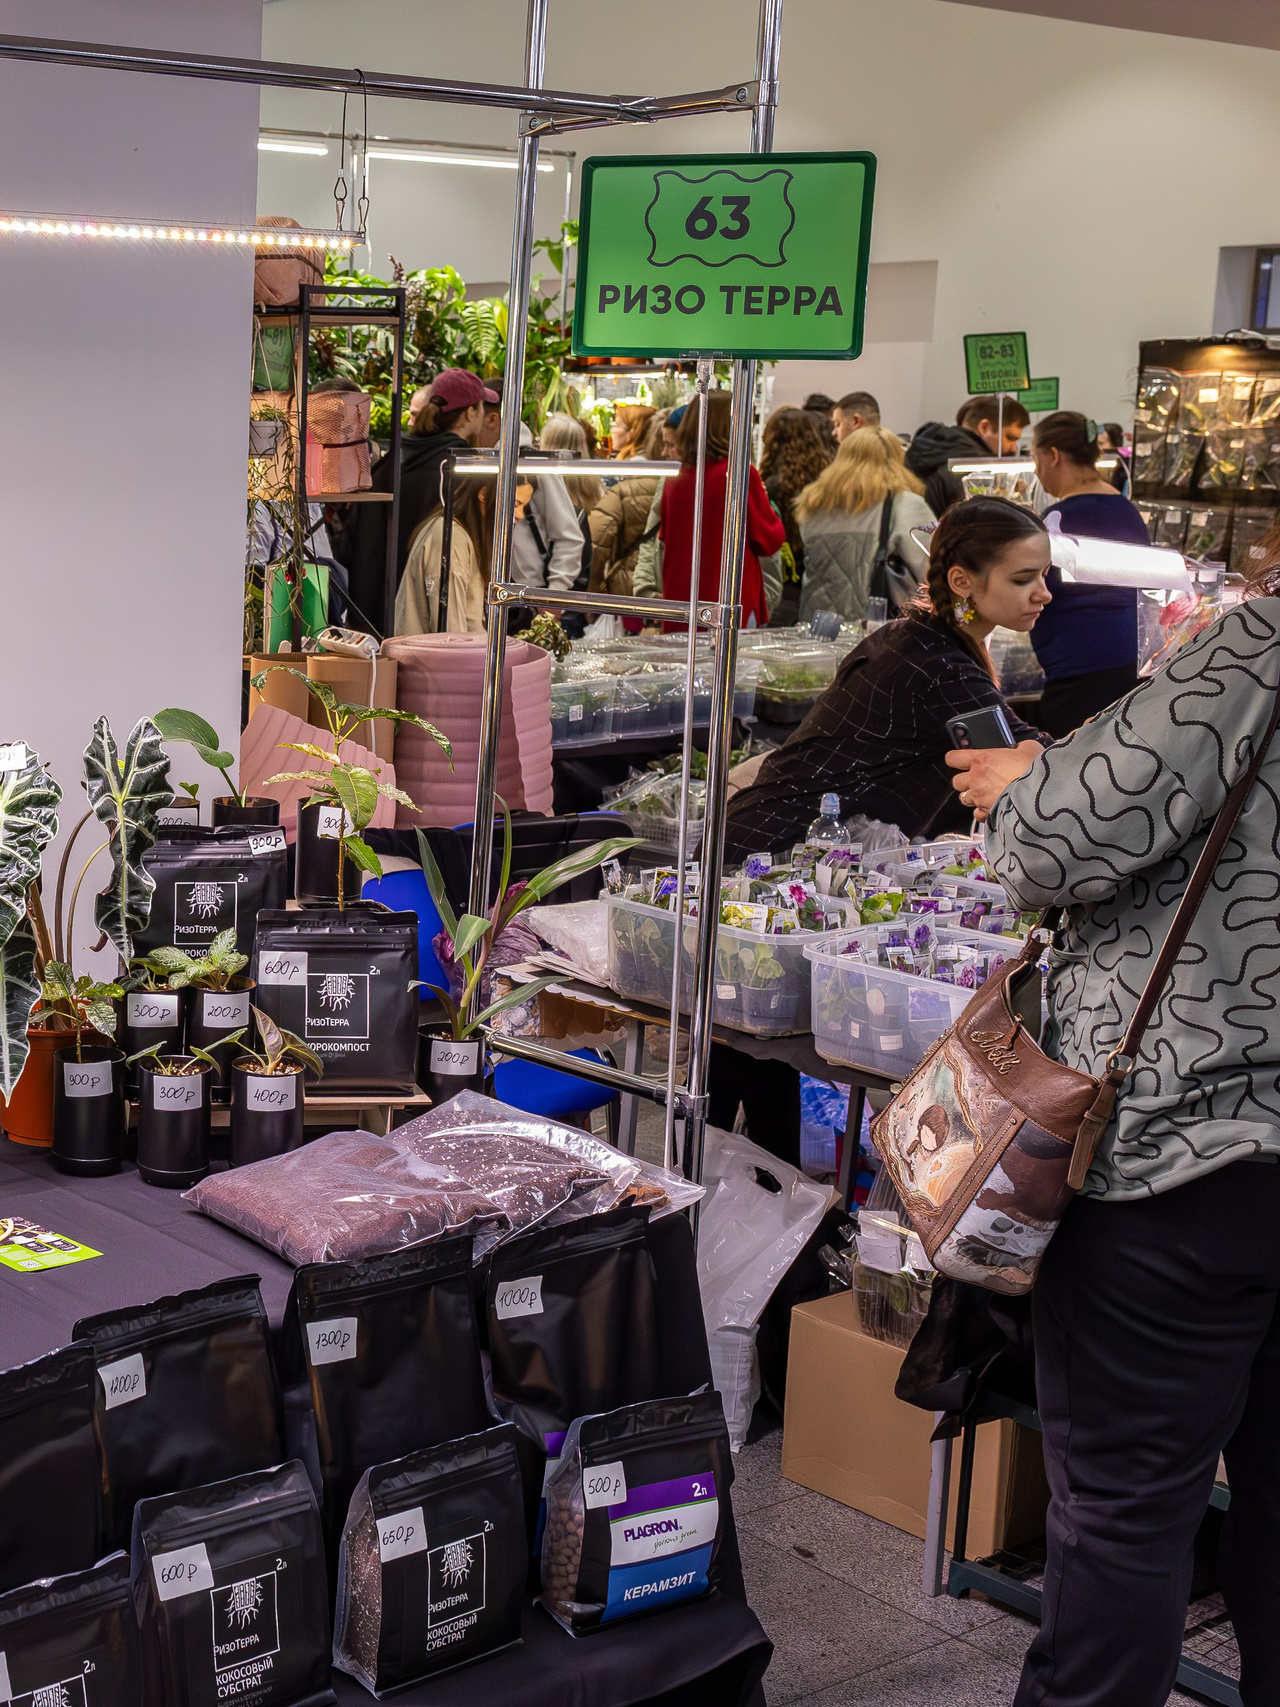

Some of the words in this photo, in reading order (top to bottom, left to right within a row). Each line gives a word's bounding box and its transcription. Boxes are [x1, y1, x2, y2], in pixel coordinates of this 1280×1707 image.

[685, 195, 751, 240] 63
[597, 284, 706, 315] РИЗО
[719, 285, 844, 316] ТЕРРА
[980, 344, 1015, 359] 82-83
[980, 370, 1019, 380] BEGONIA
[237, 873, 249, 883] 2л
[369, 965, 381, 976] 2л
[133, 1004, 171, 1021] 300₽
[207, 1005, 242, 1020] 200₽
[436, 1051, 470, 1067] 200₽
[69, 1074, 101, 1089] 900₽
[160, 1086, 196, 1101] 300₽
[498, 1287, 538, 1309] 1000₽
[315, 1330, 351, 1351] 1300₽
[109, 1373, 140, 1396] 1200₽
[691, 1482, 708, 1497] 2л
[382, 1525, 415, 1546] 650₽
[483, 1520, 495, 1533] 2л
[652, 1535, 679, 1554] glorious
[679, 1528, 698, 1543] green
[161, 1562, 198, 1584] 600₽
[275, 1558, 288, 1571] 2л
[623, 1571, 697, 1601] КЕРАМЗИТ
[427, 1613, 478, 1641] КОКОСОВЫЙ
[426, 1630, 467, 1651] СУБСТРАТ
[82, 1660, 96, 1673] 2л
[215, 1656, 274, 1687] КОКОСОВЫЙ
[217, 1674, 262, 1698] СУБСТРАТ
